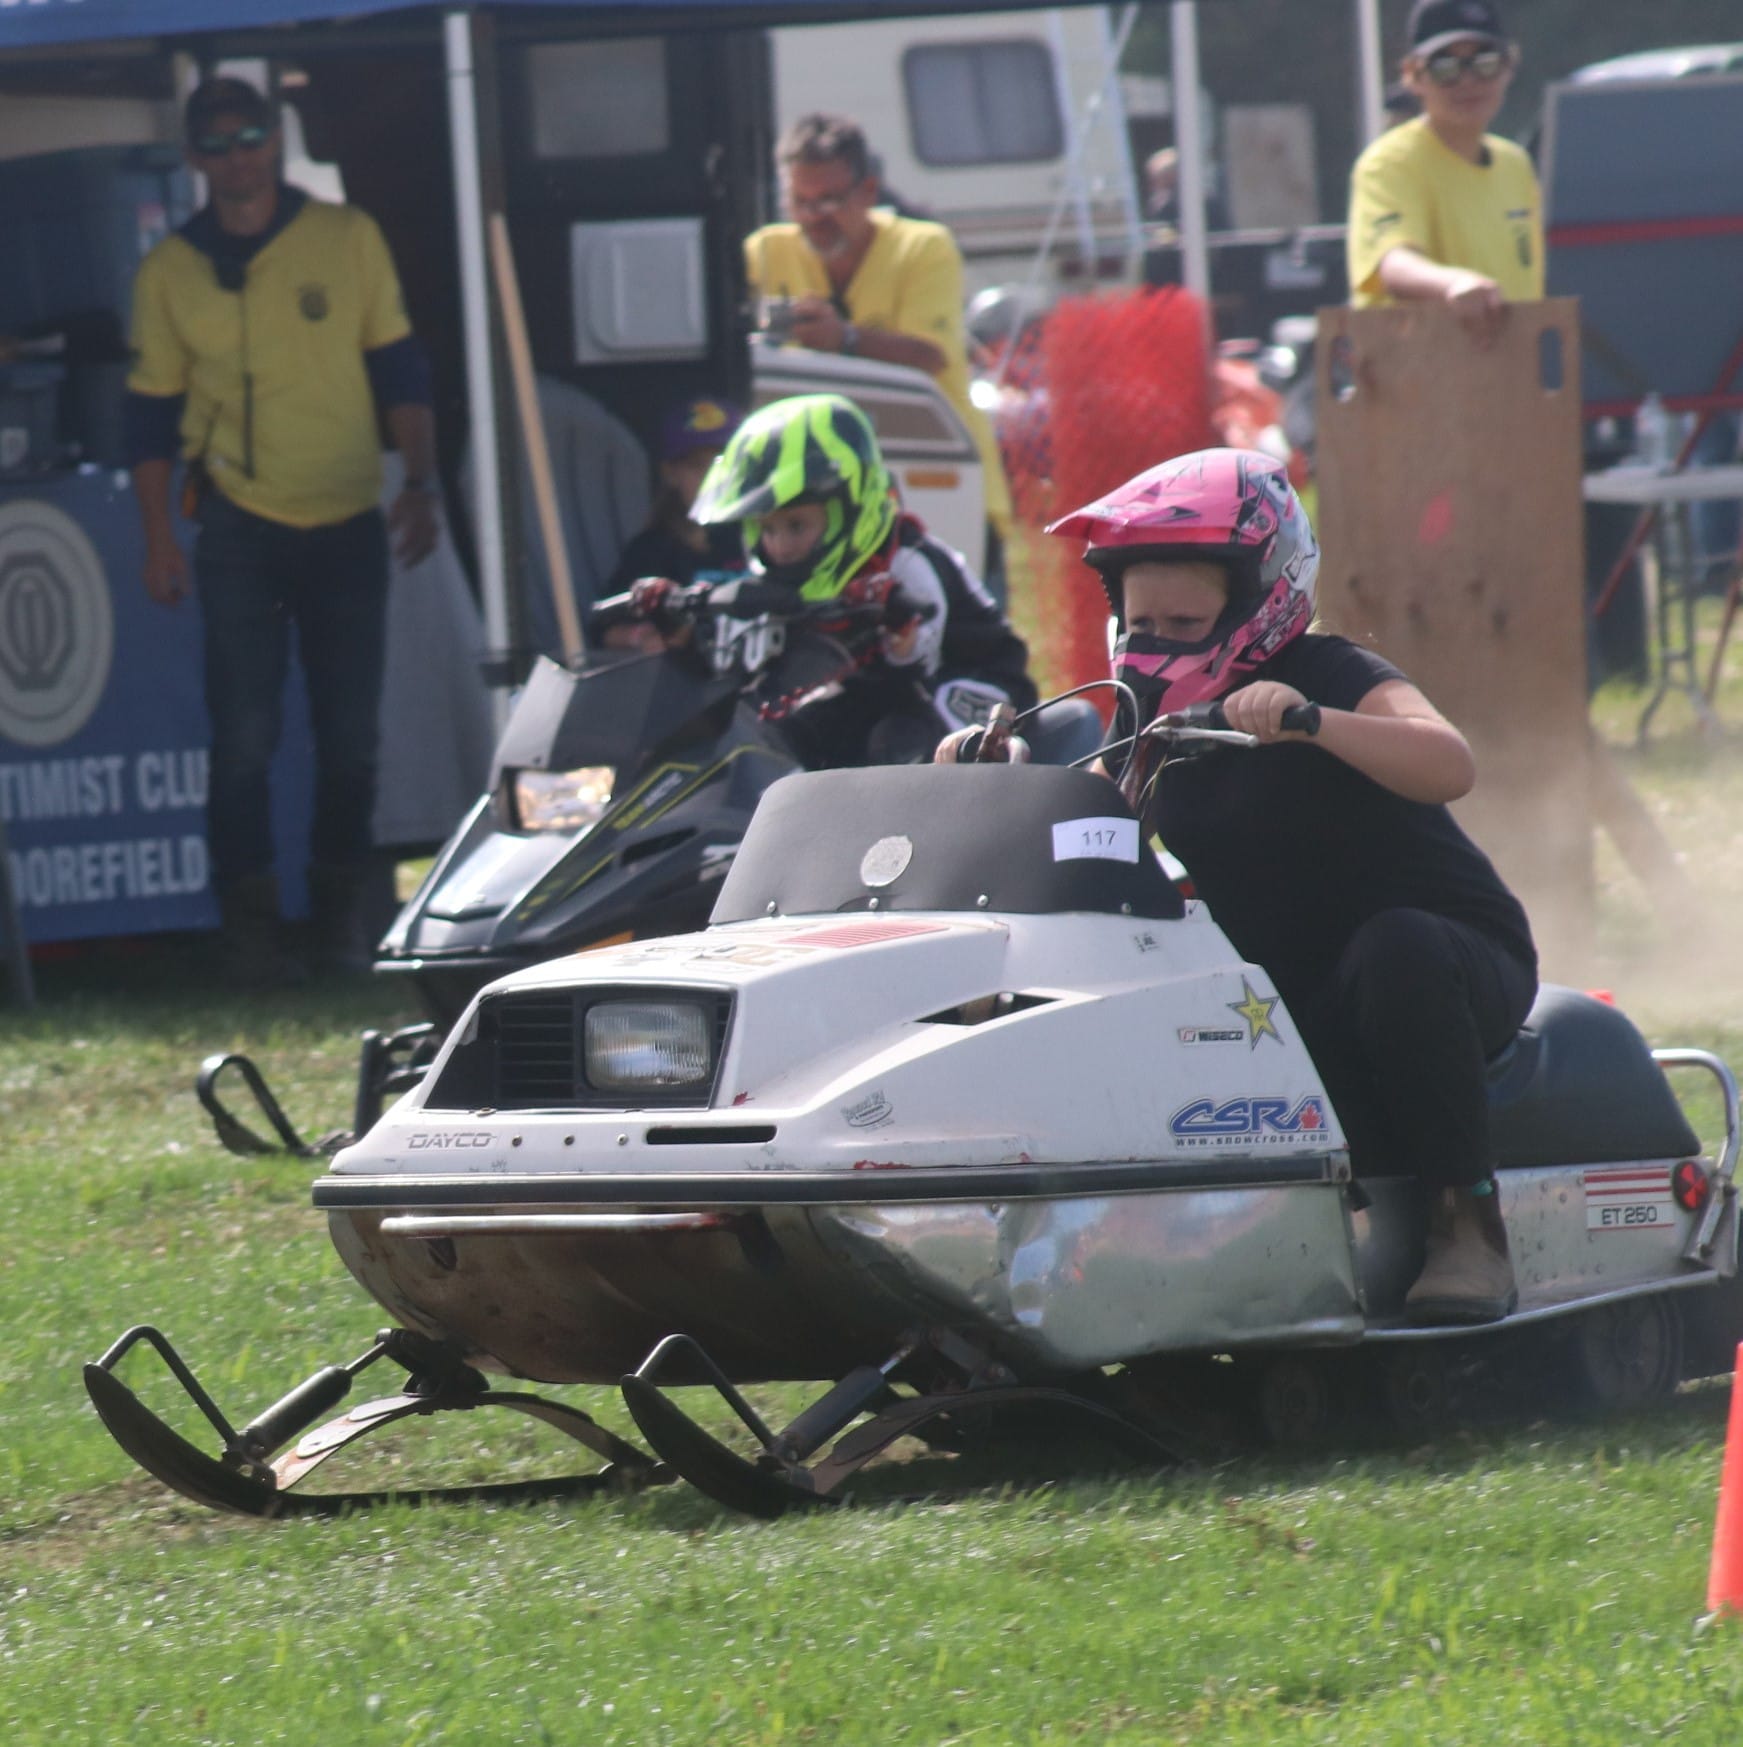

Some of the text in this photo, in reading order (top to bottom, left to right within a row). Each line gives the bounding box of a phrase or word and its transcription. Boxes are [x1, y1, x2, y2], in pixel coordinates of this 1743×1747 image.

[1082, 830, 1116, 846] 117
[1171, 1096, 1328, 1135] CSRA
[408, 1132, 494, 1149] DAYCO
[1176, 1134, 1328, 1147] www.snowcross.com
[1602, 1205, 1657, 1225] ET 250
